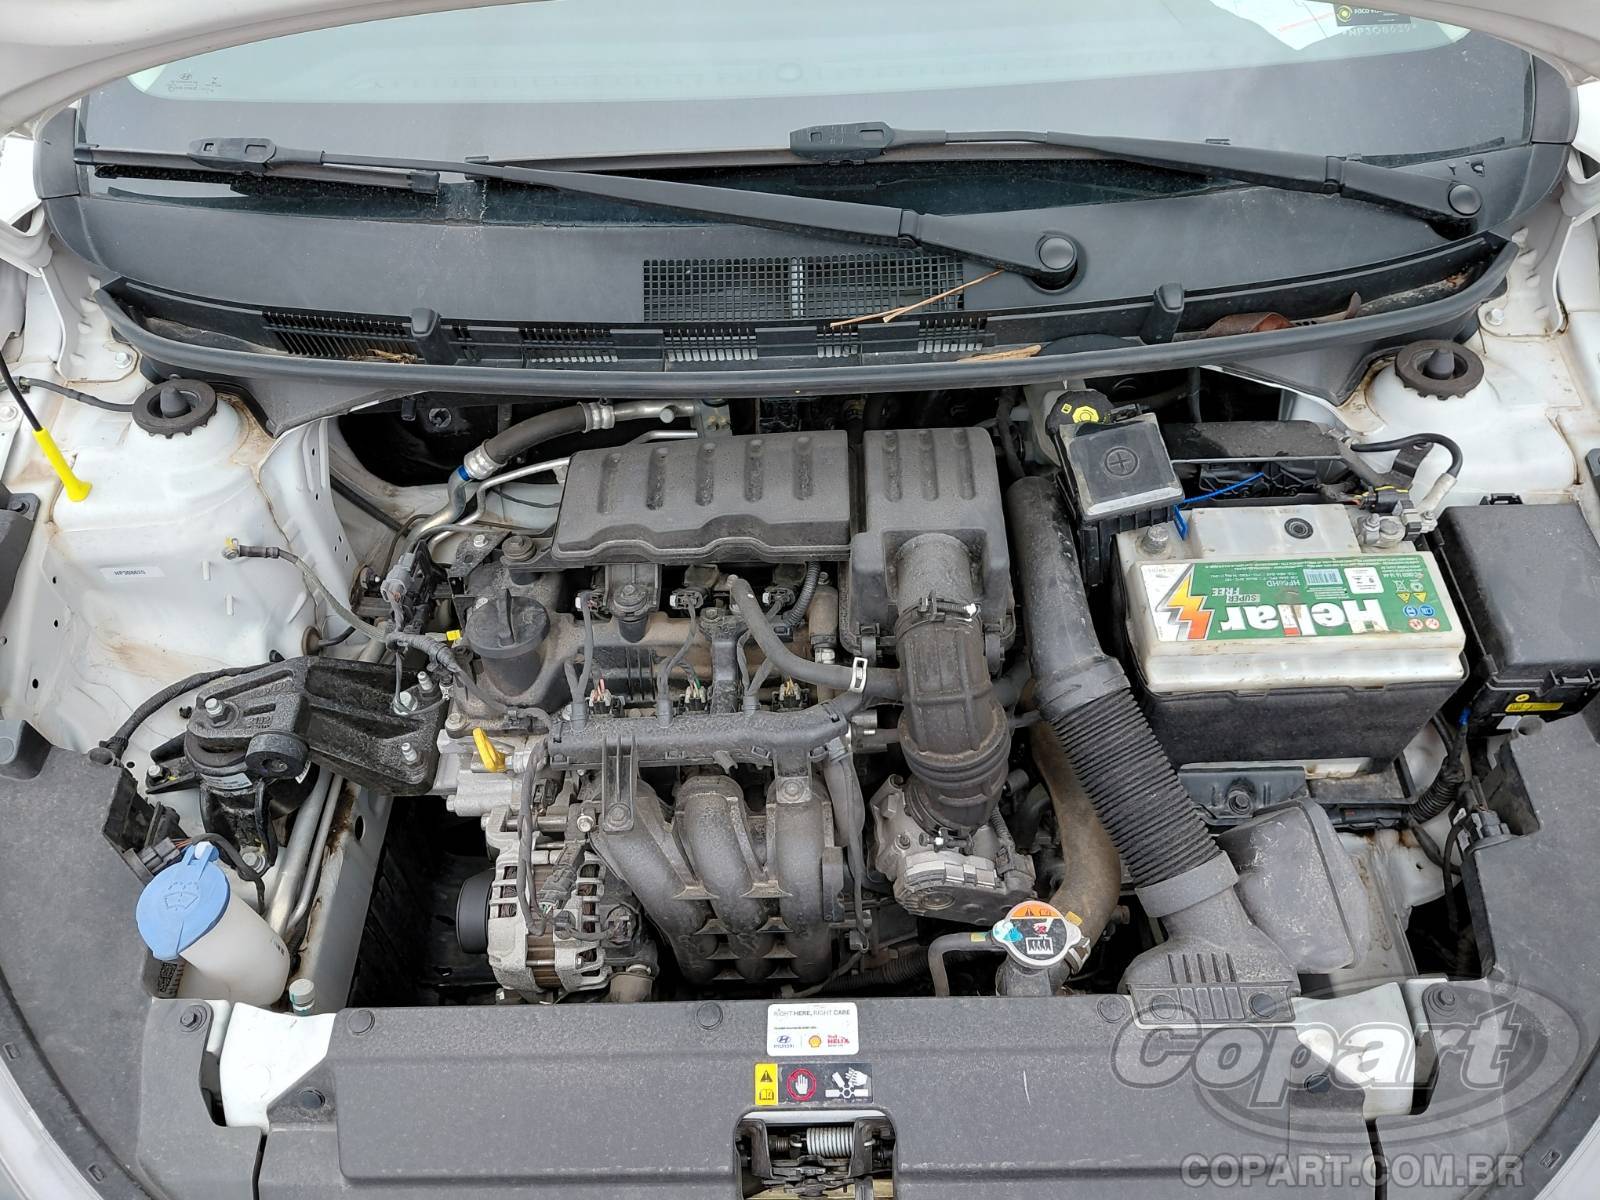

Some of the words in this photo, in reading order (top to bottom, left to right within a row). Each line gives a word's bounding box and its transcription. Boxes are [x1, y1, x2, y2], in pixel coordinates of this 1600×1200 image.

[1212, 587, 1240, 597] FREE
[1227, 594, 1257, 603] SUPER
[1219, 598, 1390, 637] Heliar
